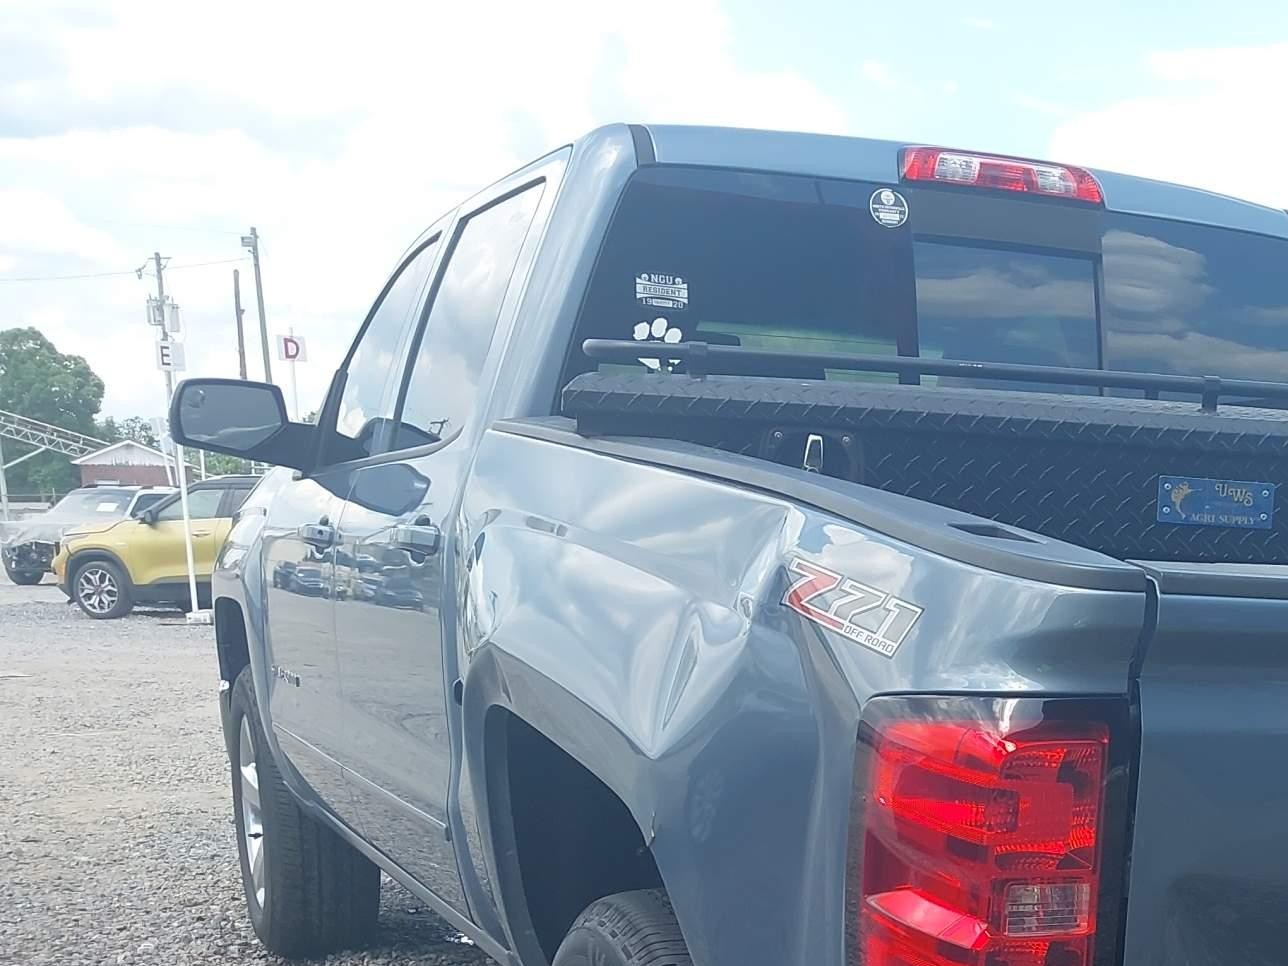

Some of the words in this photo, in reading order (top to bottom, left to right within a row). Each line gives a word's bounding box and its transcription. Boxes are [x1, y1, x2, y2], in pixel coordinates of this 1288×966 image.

[642, 285, 682, 297] RESIDENT
[160, 345, 171, 366] E
[283, 338, 300, 359] D
[1215, 483, 1253, 507] UWS
[1219, 514, 1257, 526] SUPPLY
[780, 557, 925, 648] Z71
[844, 624, 864, 639] OFF
[864, 633, 895, 654] ROAD
